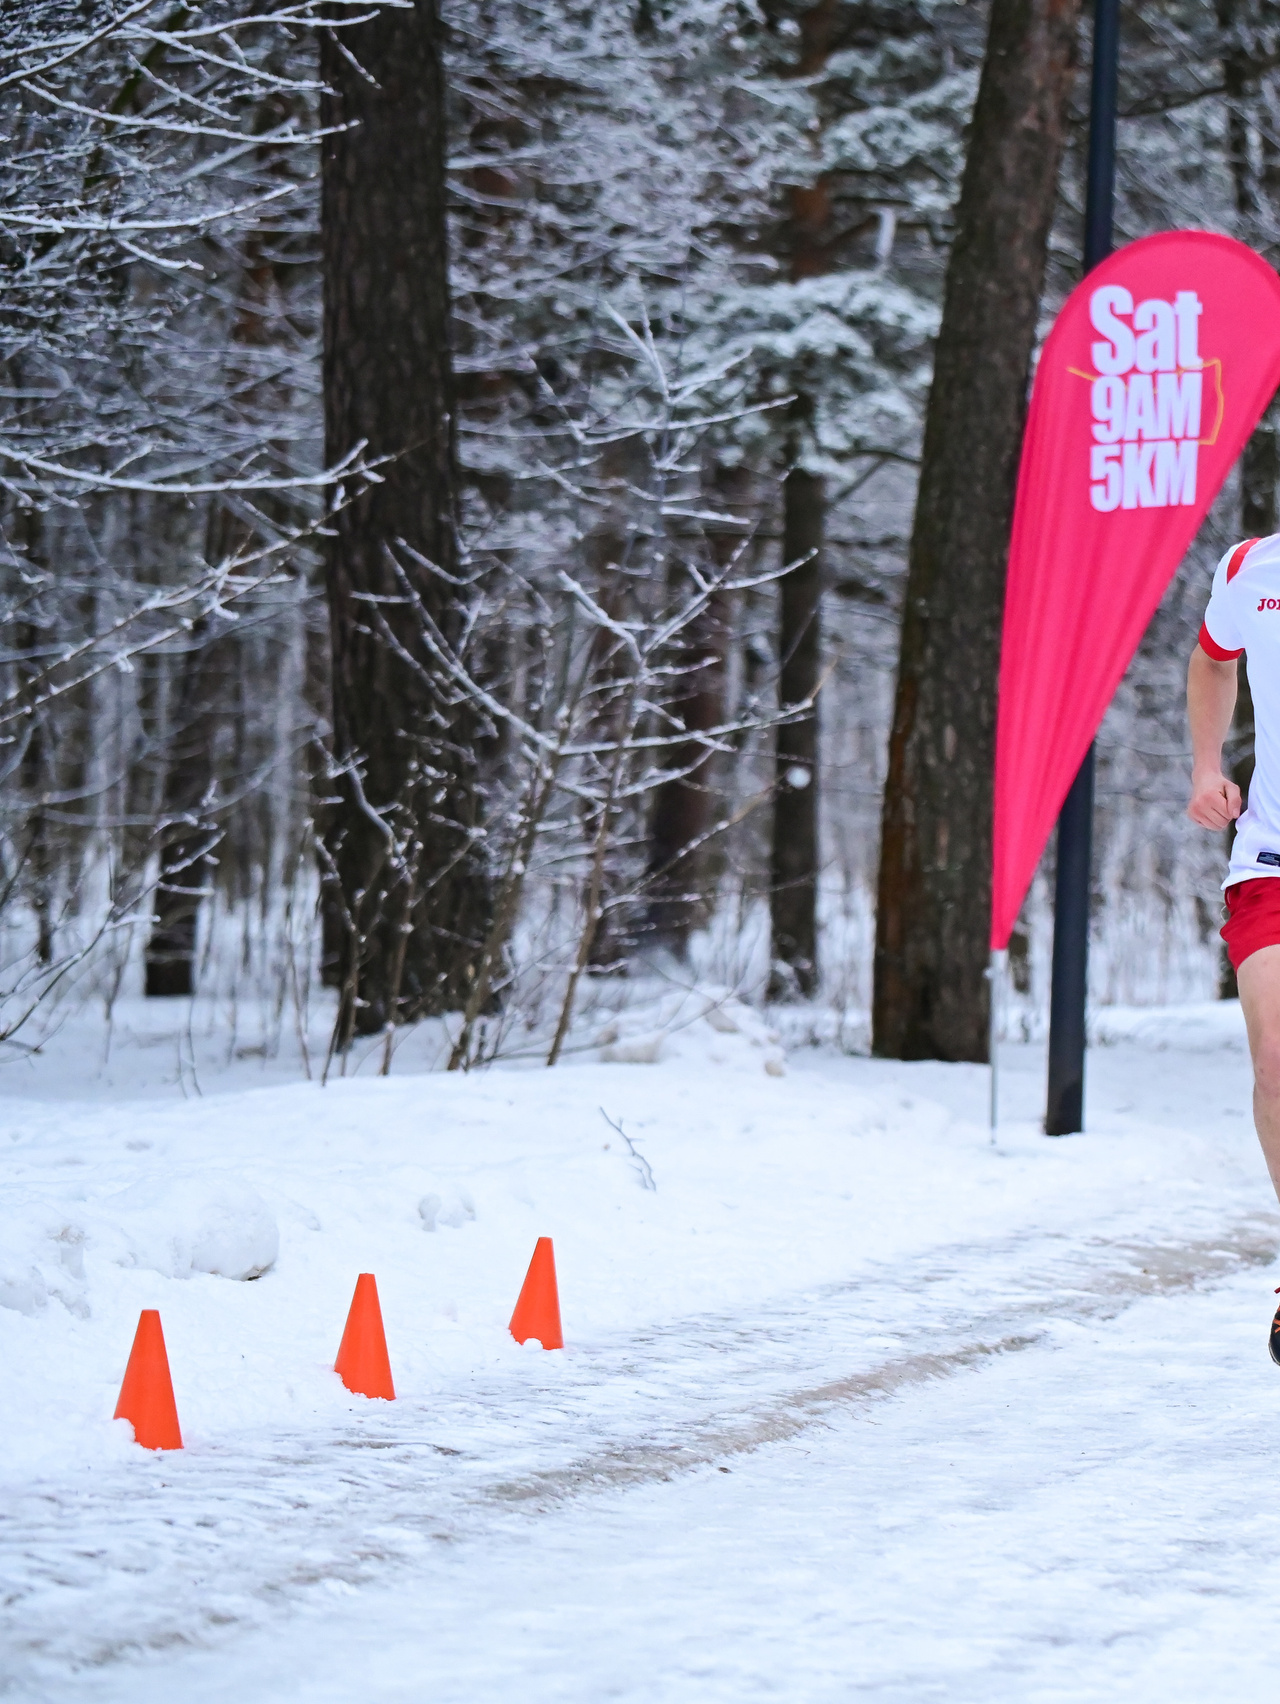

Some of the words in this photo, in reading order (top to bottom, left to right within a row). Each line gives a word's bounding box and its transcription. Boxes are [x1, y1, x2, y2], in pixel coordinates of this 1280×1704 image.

[1089, 284, 1203, 376] Sat
[1090, 371, 1203, 445] 9AM
[1089, 440, 1200, 513] 5KM
